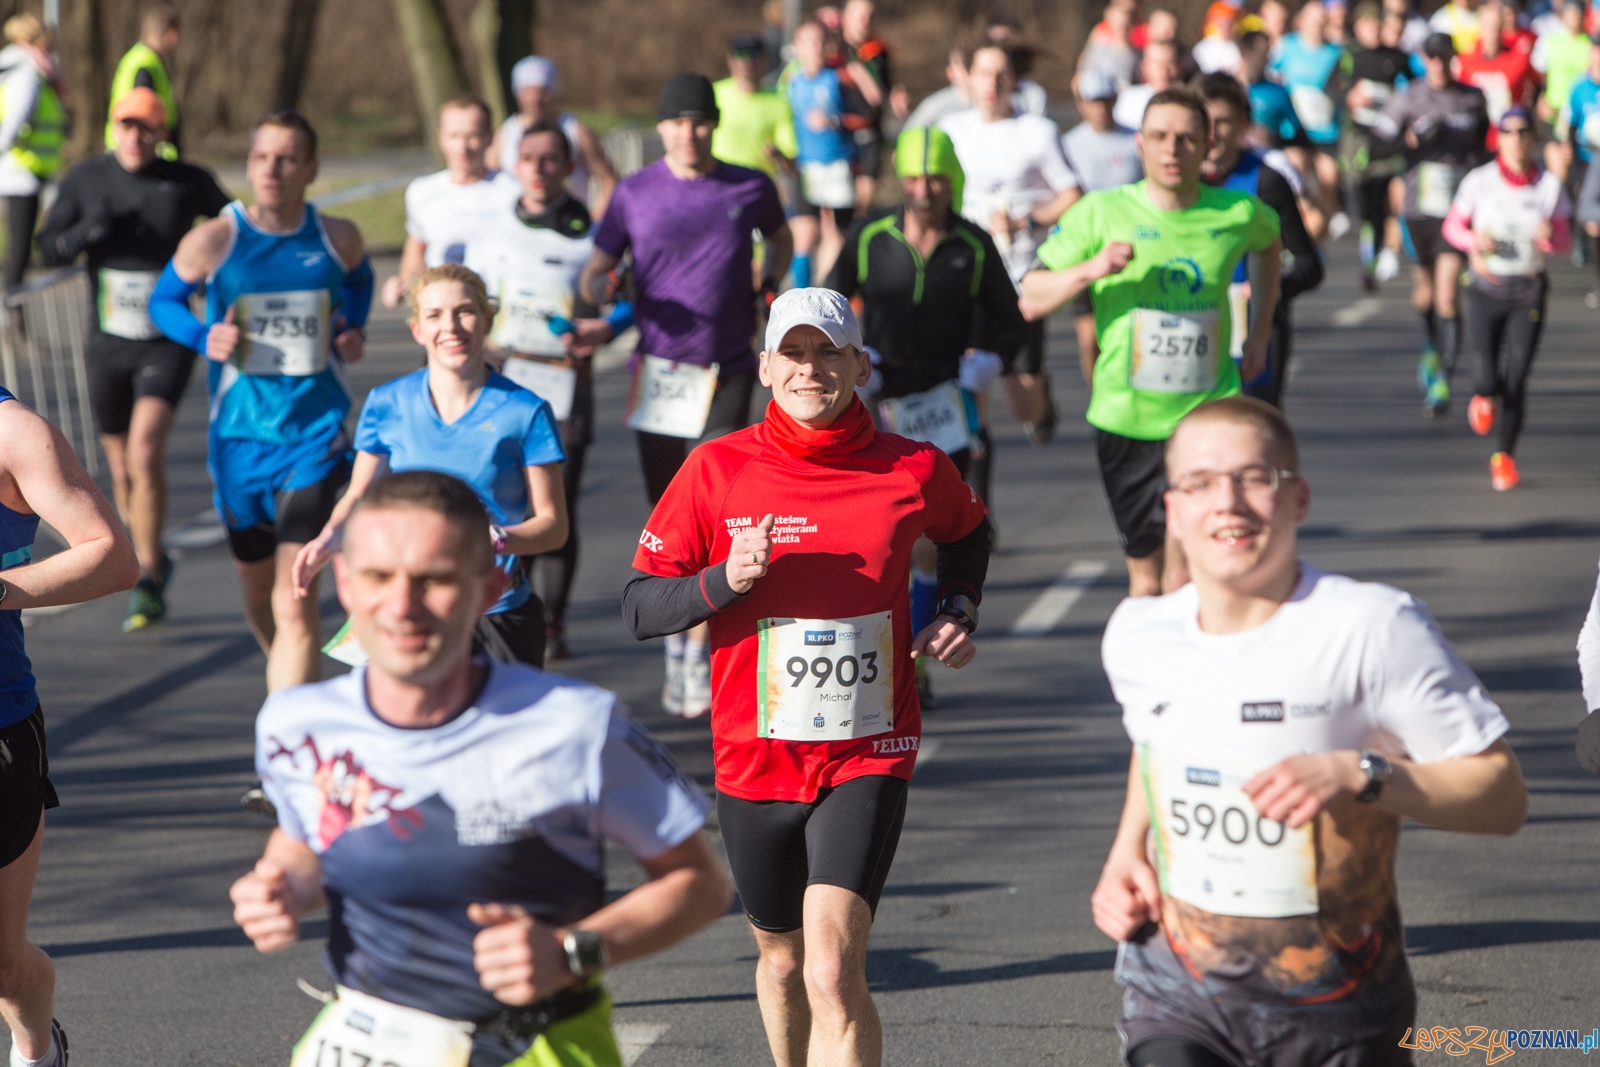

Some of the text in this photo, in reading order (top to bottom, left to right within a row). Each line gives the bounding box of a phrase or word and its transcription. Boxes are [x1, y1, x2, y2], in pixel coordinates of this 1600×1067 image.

[1150, 334, 1209, 358] 2578
[725, 515, 808, 528] TEAM steśmy
[771, 524, 818, 536] żynierami
[771, 534, 800, 544] wiatła
[817, 634, 834, 642] PKO
[786, 651, 878, 688] 9903
[820, 692, 853, 702] Michał
[872, 736, 919, 753] VELUX
[1171, 798, 1286, 847] 5900
